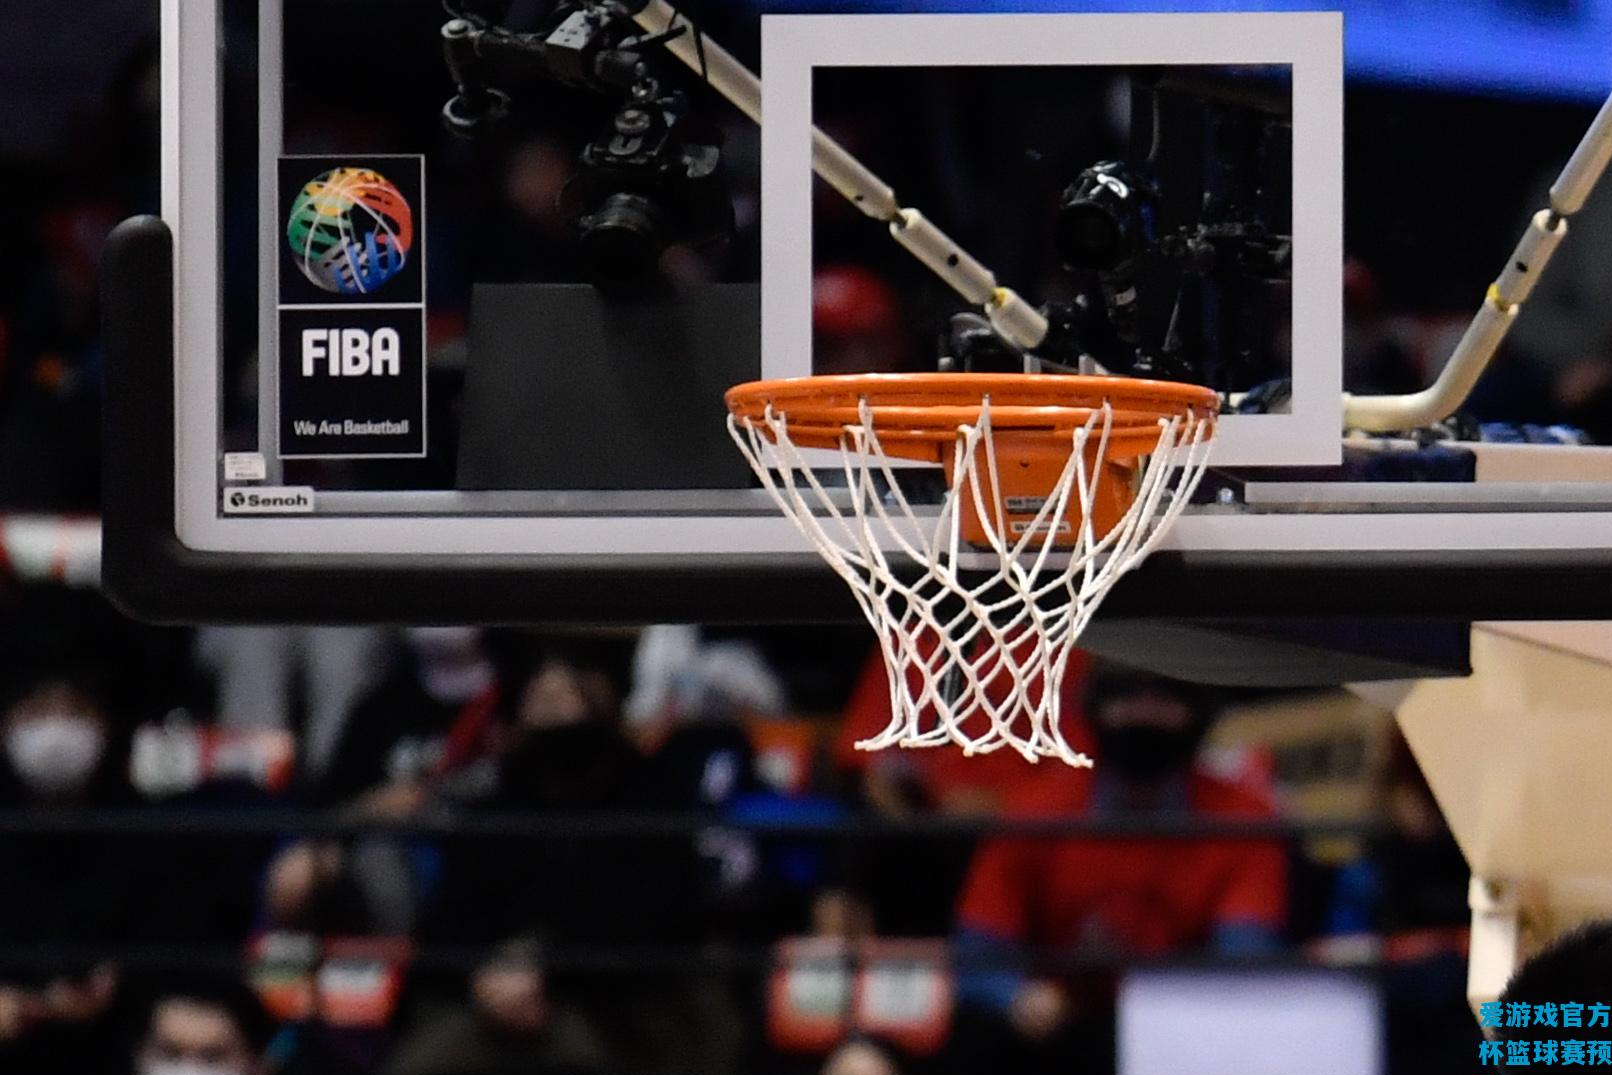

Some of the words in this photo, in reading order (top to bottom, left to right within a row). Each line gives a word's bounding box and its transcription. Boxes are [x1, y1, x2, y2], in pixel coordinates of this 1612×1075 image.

[302, 327, 400, 377] FIBA
[294, 420, 316, 435] We
[319, 420, 342, 435] Are
[344, 419, 409, 434] Basketball
[248, 494, 308, 507] Senoh
